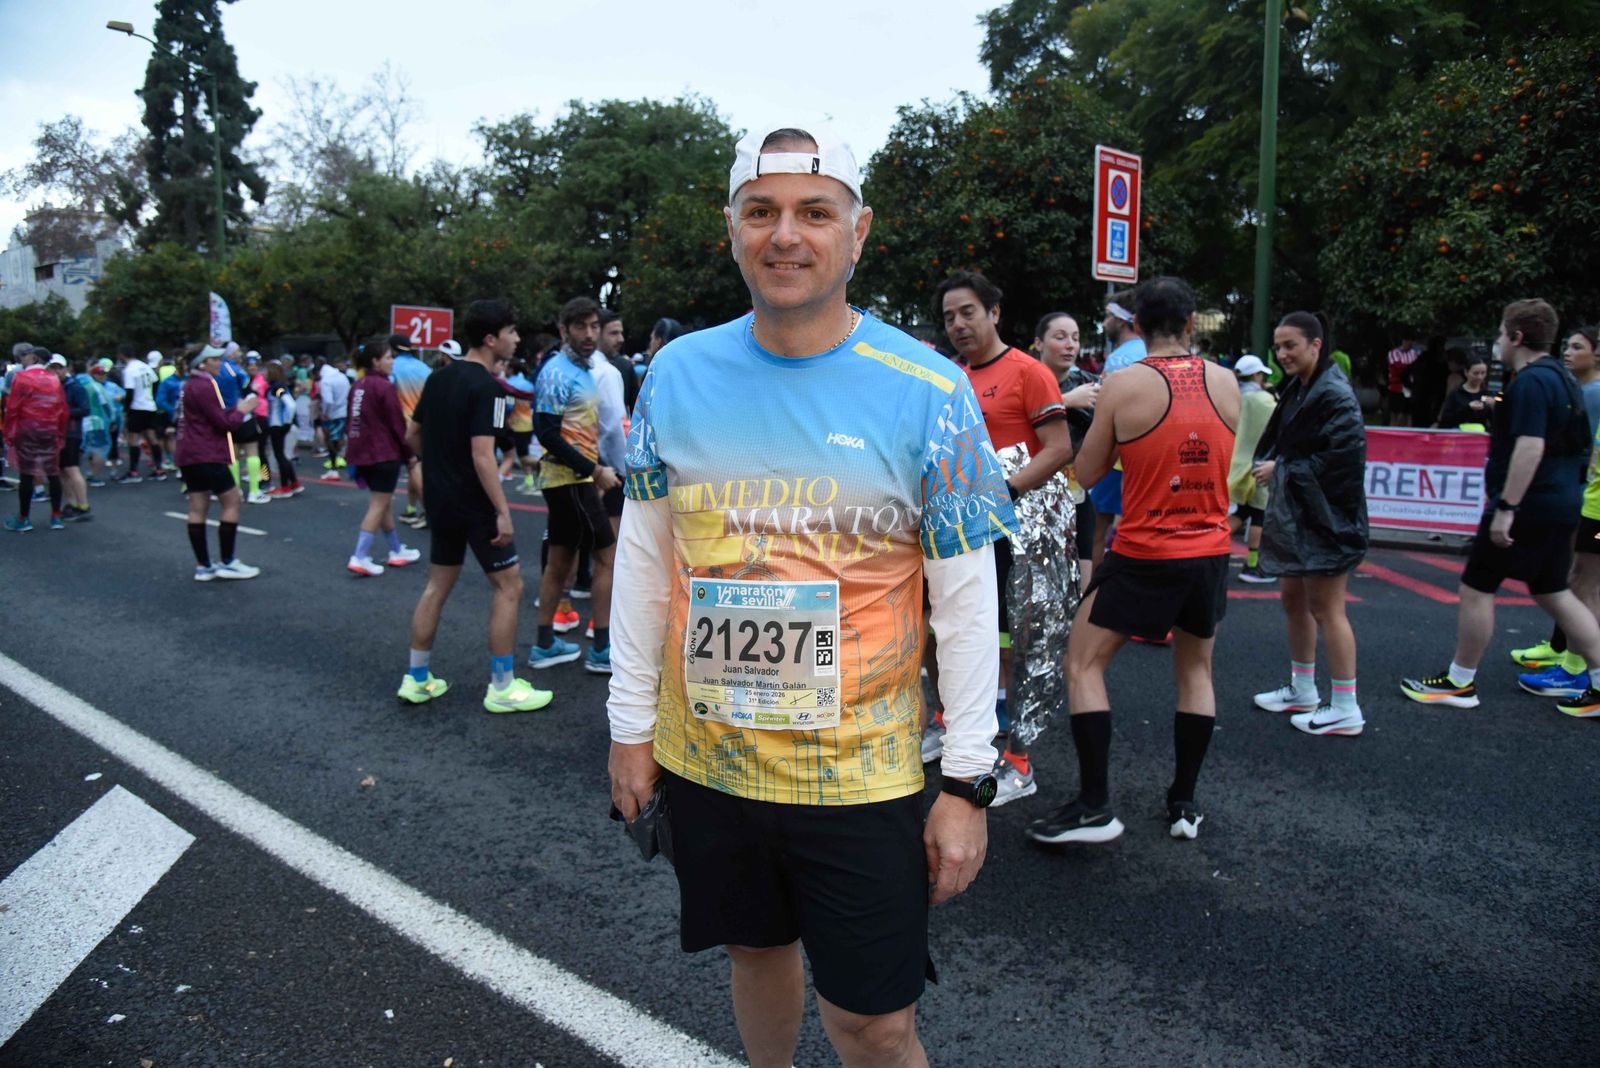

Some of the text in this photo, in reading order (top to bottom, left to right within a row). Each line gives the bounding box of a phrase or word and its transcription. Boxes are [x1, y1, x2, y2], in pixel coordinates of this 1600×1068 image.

[409, 316, 433, 345] 21
[826, 431, 866, 450] HOKA
[702, 475, 839, 511] MEDIO
[1364, 465, 1482, 501] REATE
[725, 498, 922, 537] MARATÓN
[741, 532, 894, 564] SEVILLA
[732, 584, 783, 597] maratón
[741, 594, 784, 607] sevilla
[694, 616, 813, 664] 21237
[722, 664, 780, 677] Juan Salvador
[702, 676, 807, 690] Juan Salvador Martín Galán
[731, 711, 753, 721] HOKA
